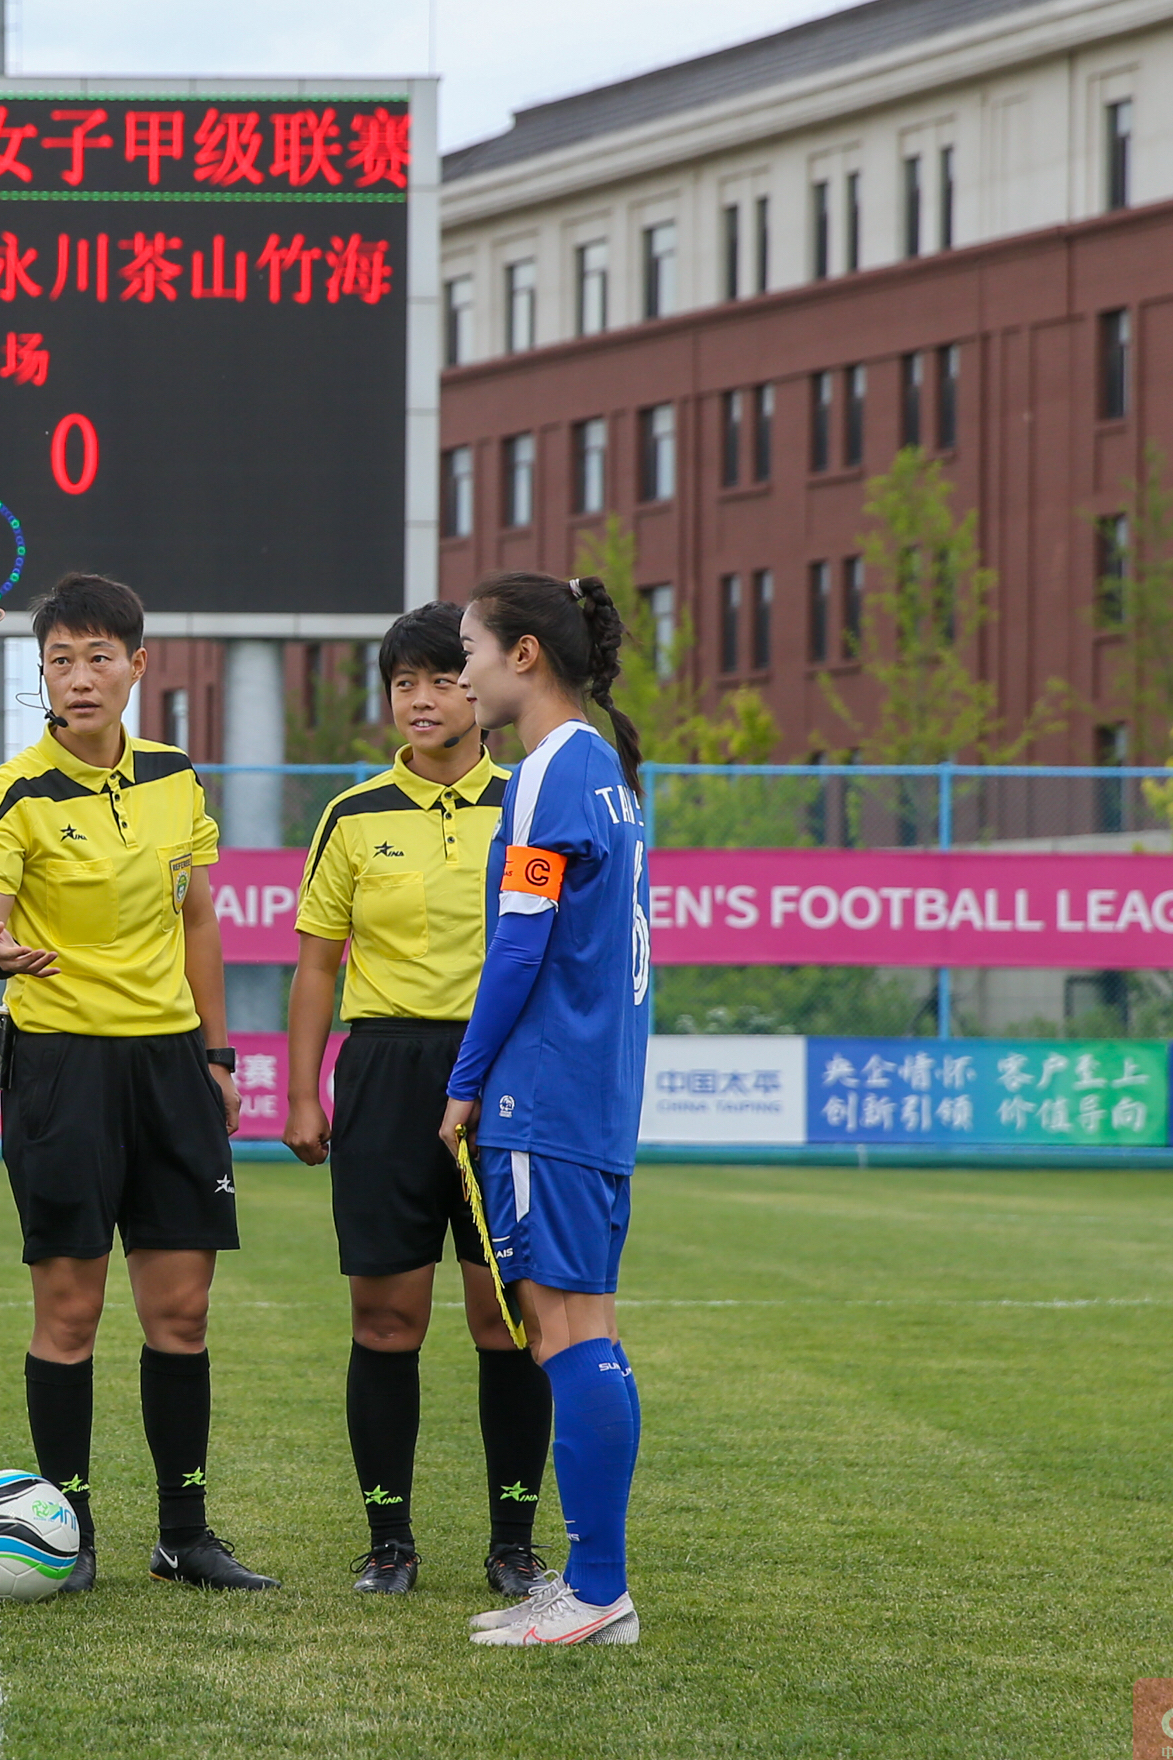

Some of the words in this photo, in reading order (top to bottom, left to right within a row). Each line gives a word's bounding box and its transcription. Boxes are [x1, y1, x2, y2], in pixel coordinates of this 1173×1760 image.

[50, 412, 100, 496] 0
[525, 858, 551, 887] C
[208, 884, 302, 929] AIP
[648, 884, 759, 928] EN'S
[770, 885, 1044, 931] FOOTBALL
[656, 1068, 782, 1097] 中国太平
[821, 1091, 974, 1133] 创新引领
